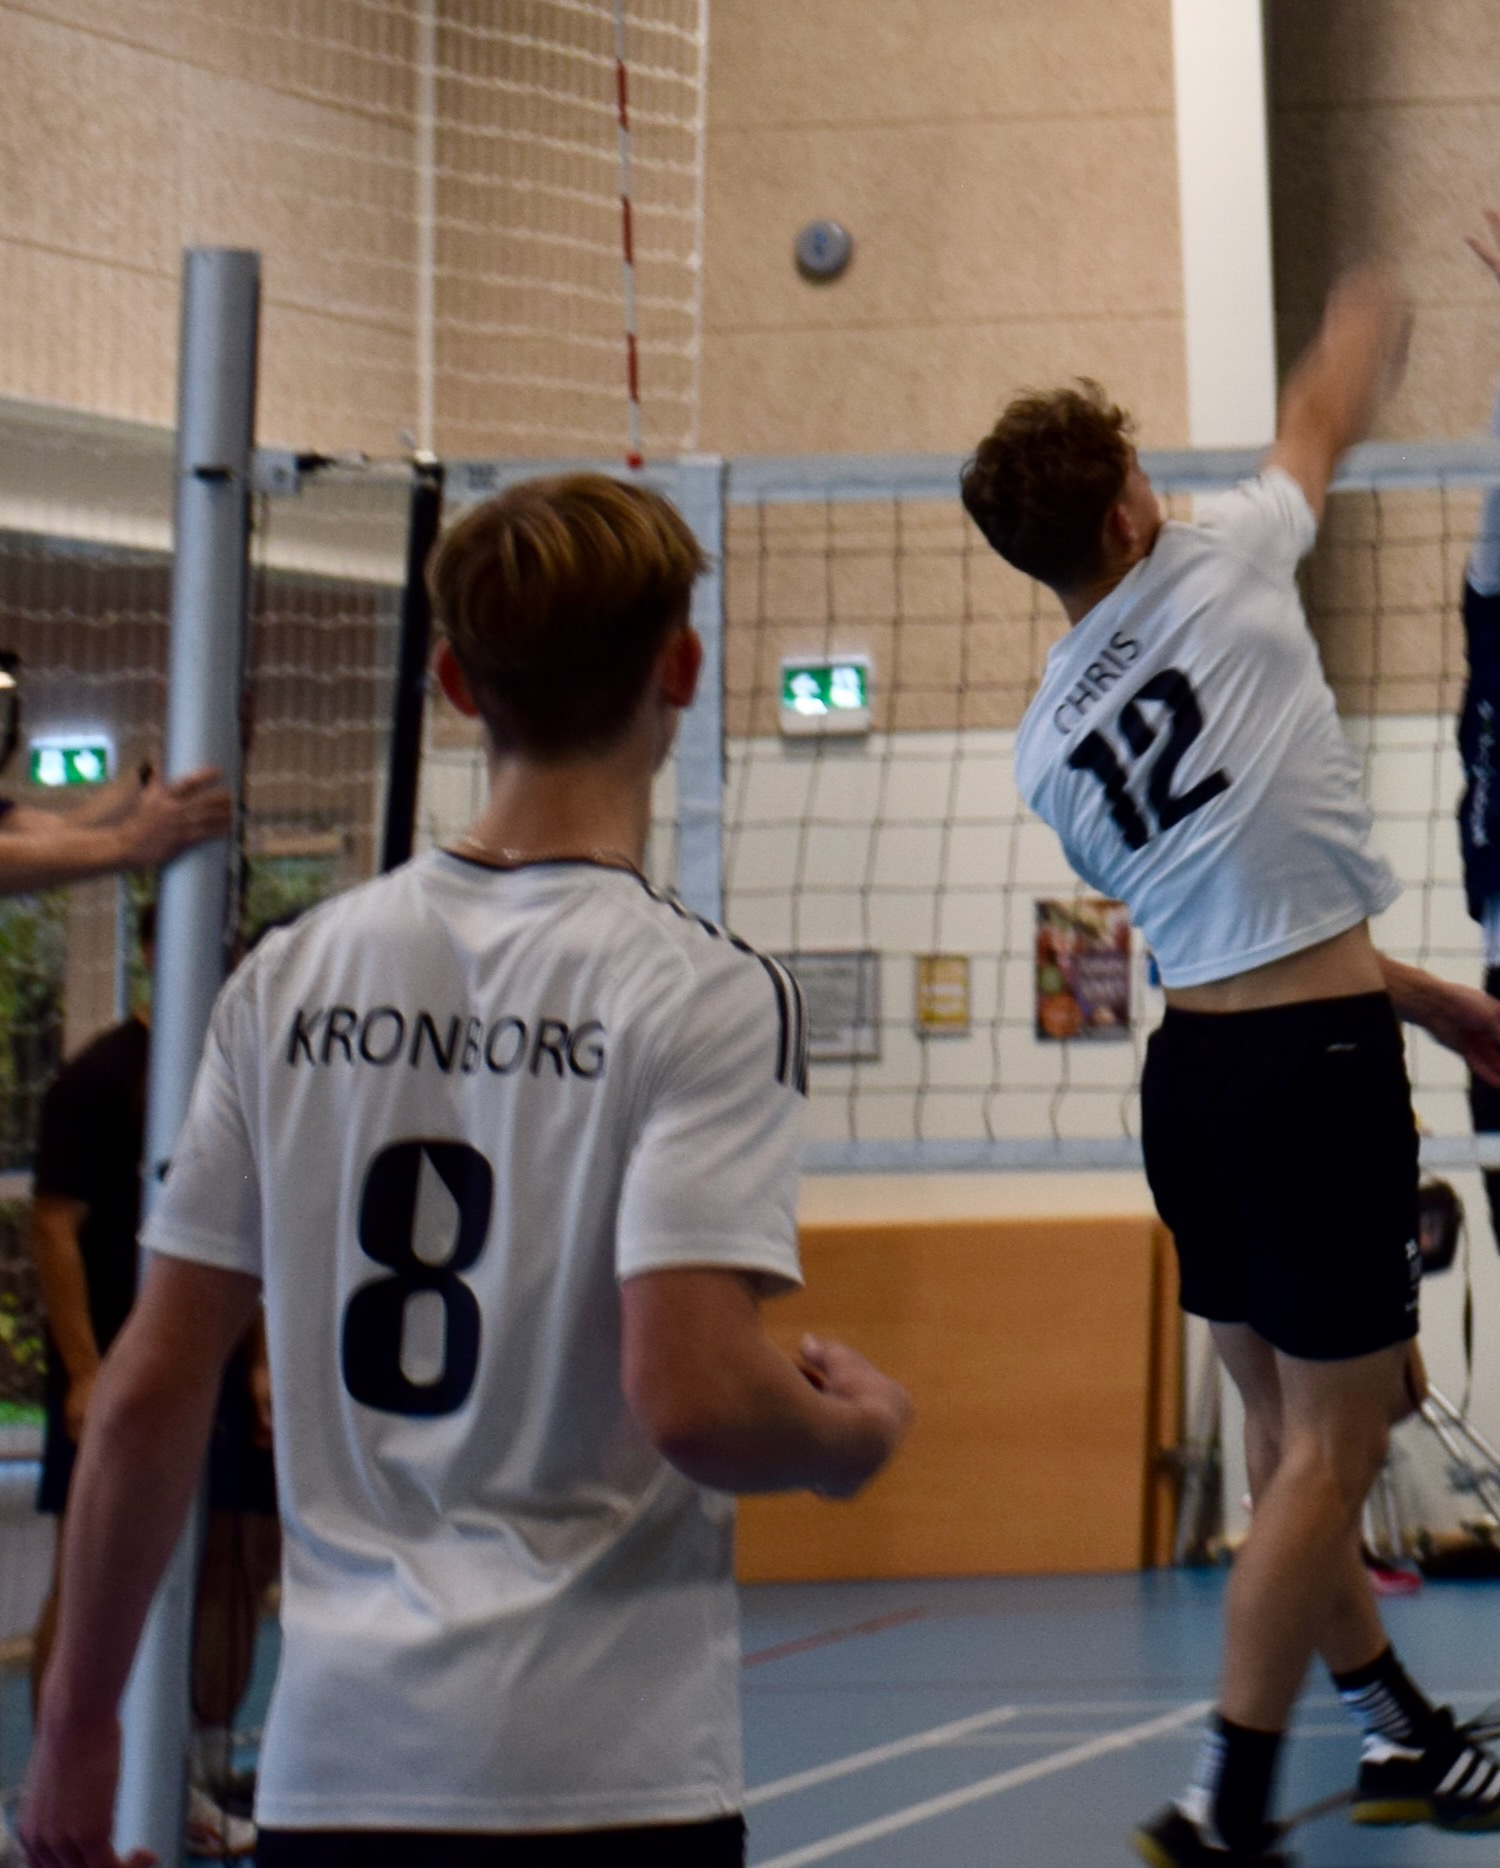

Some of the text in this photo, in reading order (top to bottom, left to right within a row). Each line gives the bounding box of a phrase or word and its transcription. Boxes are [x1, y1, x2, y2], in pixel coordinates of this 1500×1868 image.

[1053, 631, 1141, 735] CHRIS
[1066, 667, 1234, 851] 12
[286, 1004, 608, 1080] KRONBORG
[341, 1138, 495, 1419] 8
